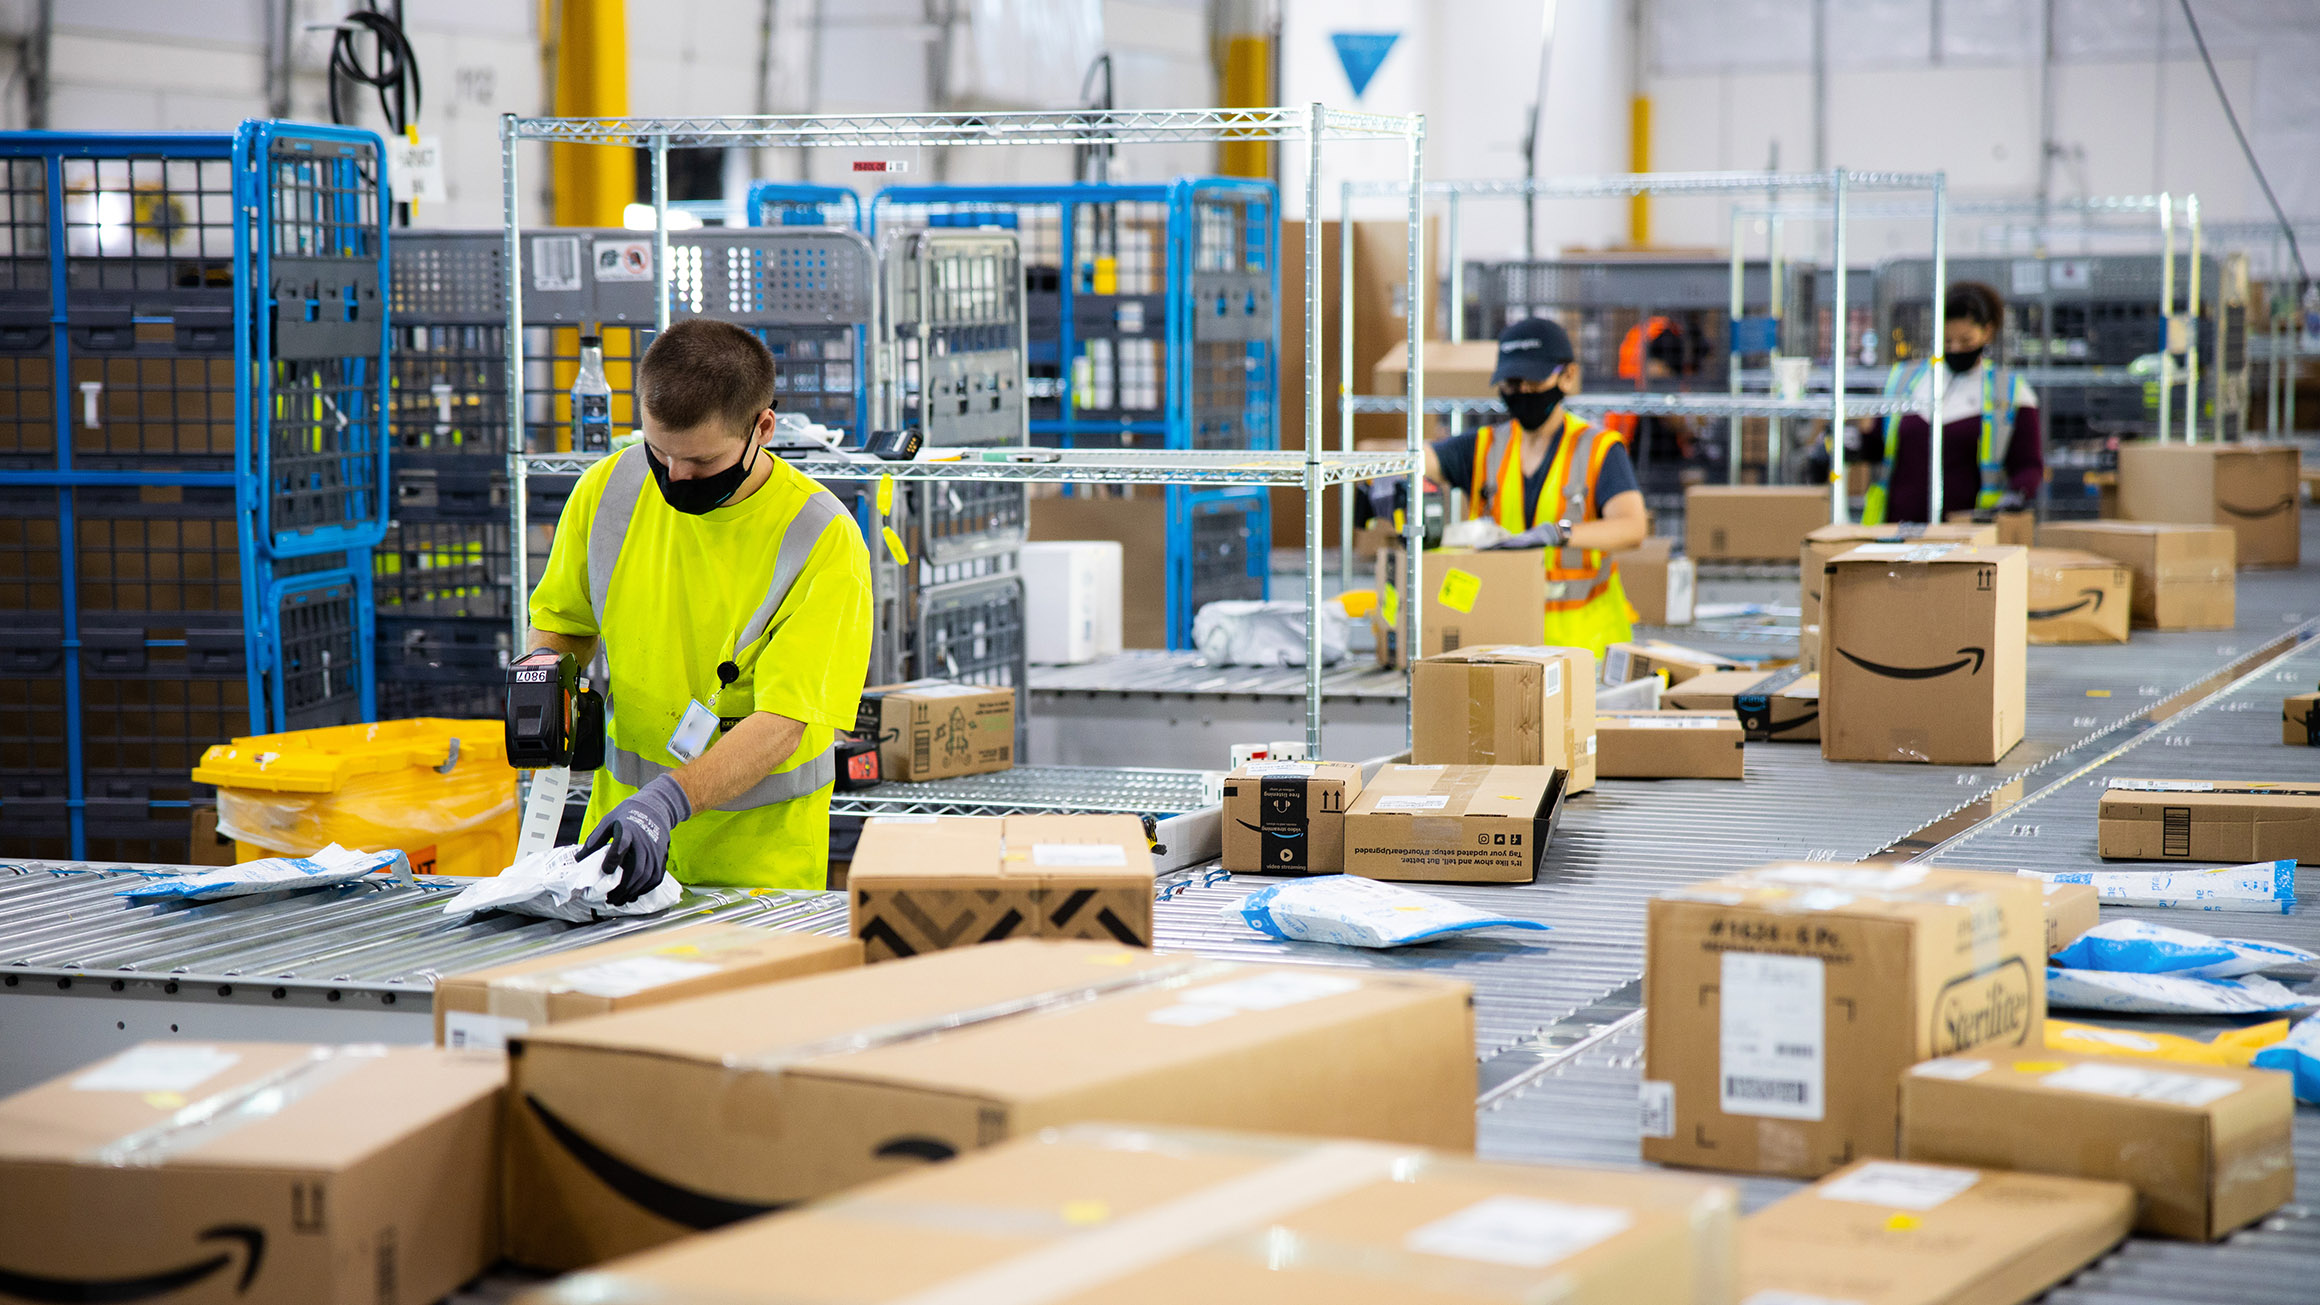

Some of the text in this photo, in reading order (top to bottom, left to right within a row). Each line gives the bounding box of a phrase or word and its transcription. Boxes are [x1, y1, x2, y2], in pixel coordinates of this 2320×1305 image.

[517, 671, 546, 682] 9807
[1354, 847, 1522, 858] Tag your updated setup: #YourGearUpgraded
[1401, 857, 1425, 865] better.
[1441, 858, 1456, 866] tell.
[1458, 858, 1473, 866] and
[1510, 859, 1522, 867] It's
